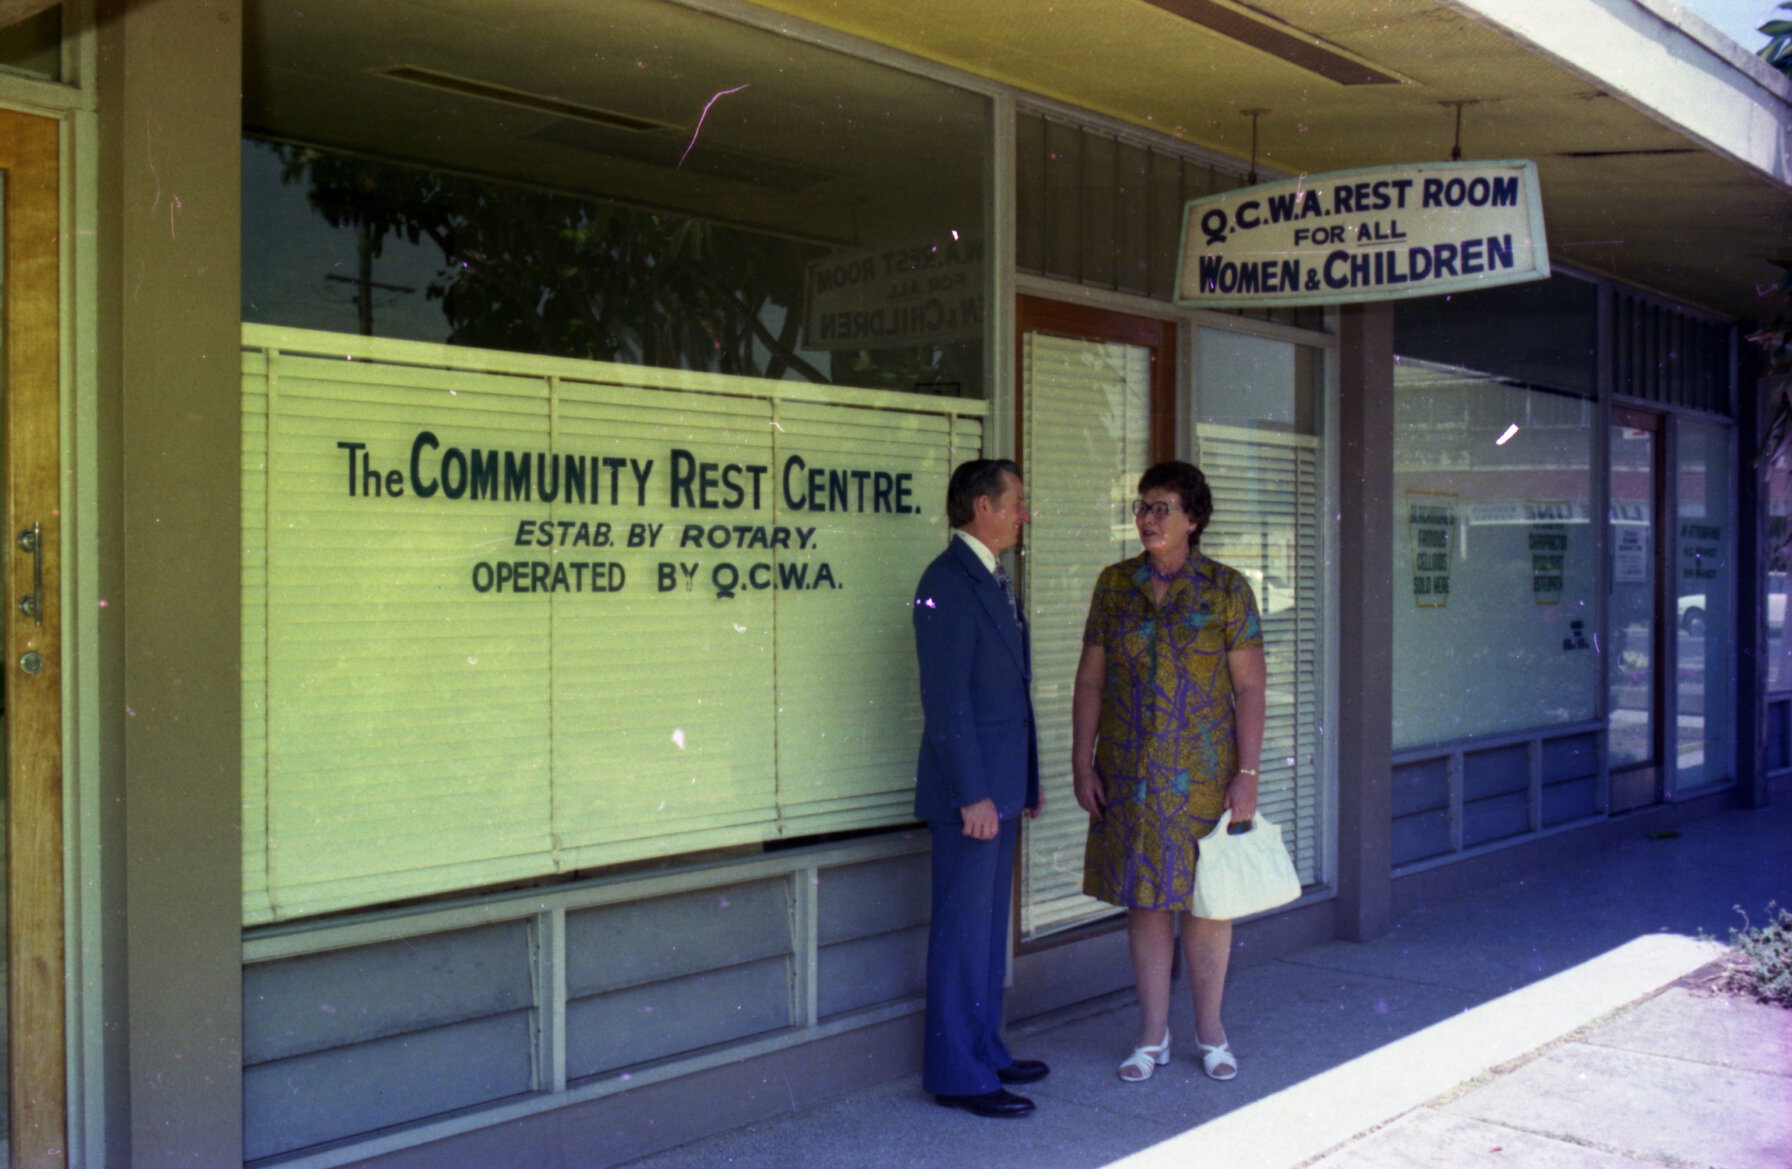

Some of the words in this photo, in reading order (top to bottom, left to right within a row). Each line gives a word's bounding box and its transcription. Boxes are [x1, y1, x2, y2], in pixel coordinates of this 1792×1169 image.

[1334, 179, 1413, 215] REST
[1422, 176, 1519, 209] ROOM
[1294, 226, 1345, 246] FOR
[1356, 220, 1407, 241] ALL
[1199, 254, 1300, 294] WOMEN
[1304, 268, 1321, 291] &
[1323, 234, 1515, 290] CHILDREN
[337, 441, 404, 498] The
[410, 431, 654, 508] COMMUNITY
[670, 449, 768, 510] REST
[783, 455, 922, 515] CENTRE.
[515, 520, 615, 548] ESTAB.
[627, 522, 664, 548] BY
[680, 523, 818, 551] ROTARY.
[472, 561, 626, 594] OPERATED
[658, 562, 700, 593] BY
[711, 562, 843, 599] Q.C.W.A.
